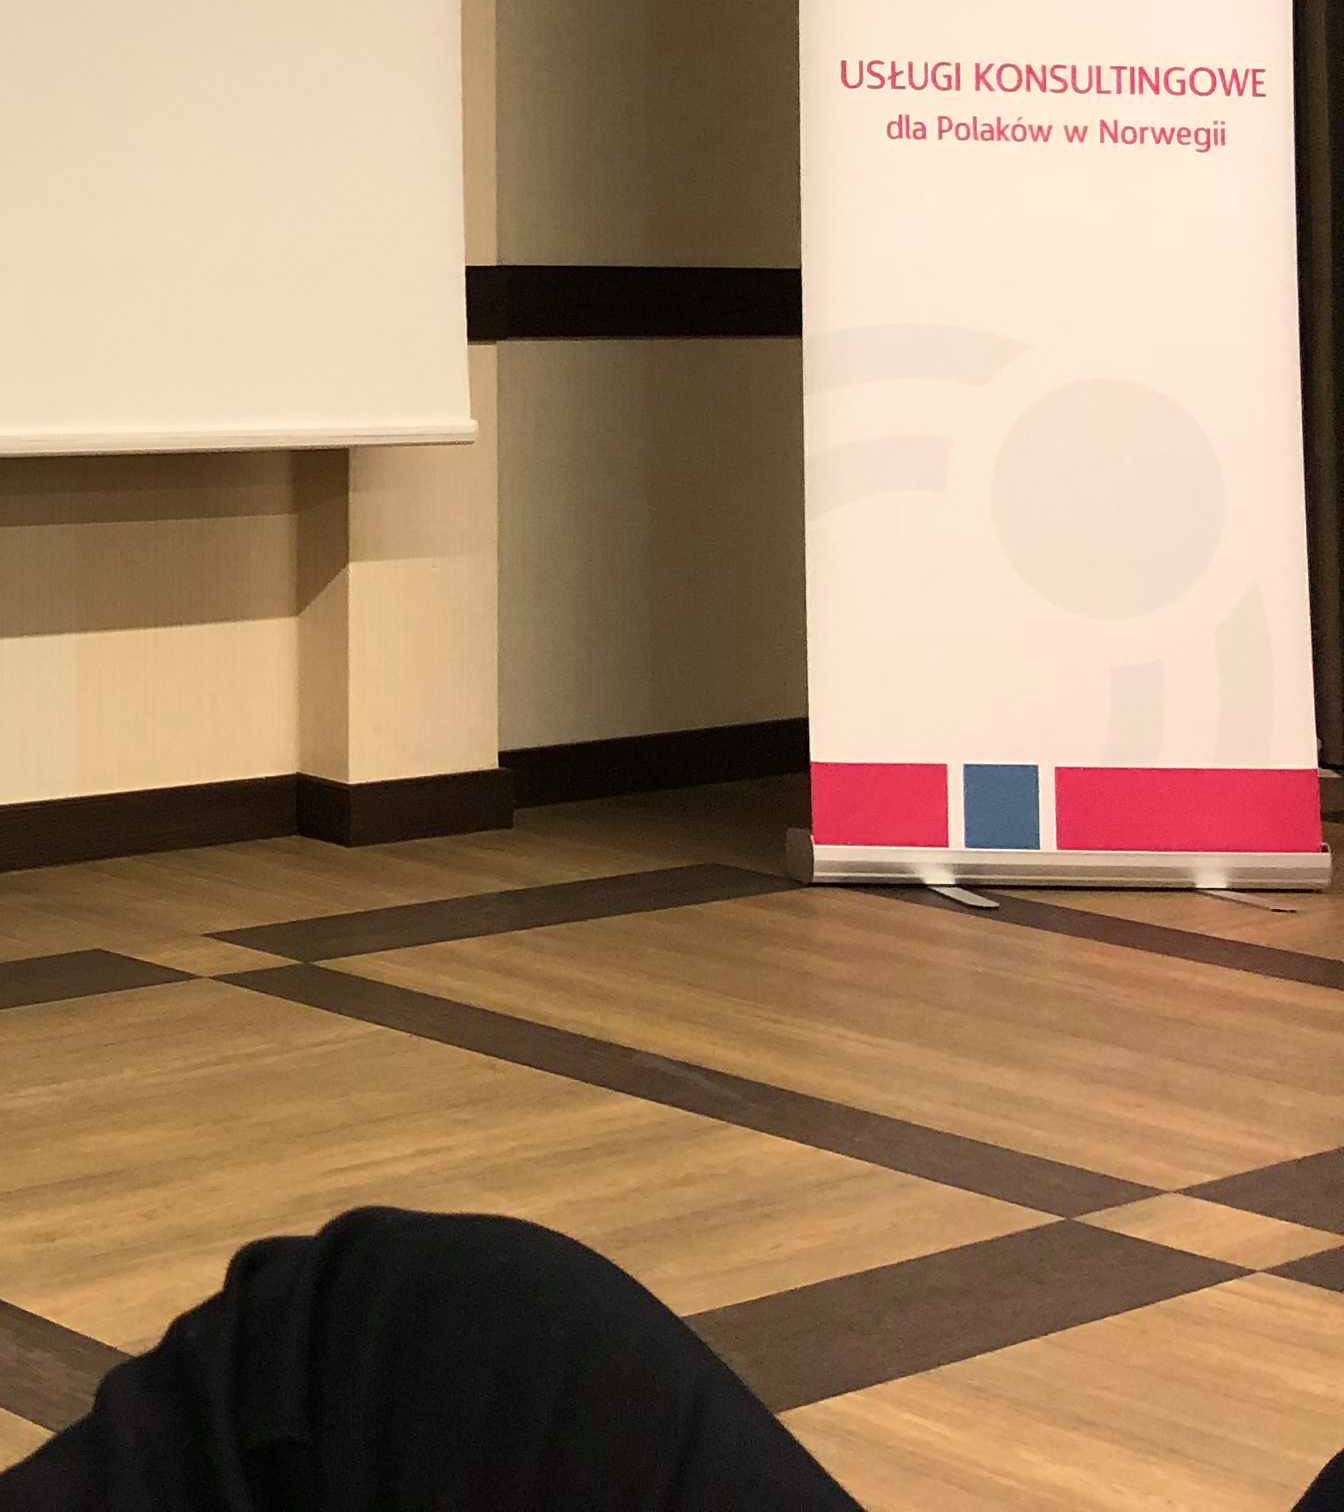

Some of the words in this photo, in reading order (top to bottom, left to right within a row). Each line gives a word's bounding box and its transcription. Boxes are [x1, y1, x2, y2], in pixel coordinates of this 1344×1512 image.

[839, 59, 962, 92] USŁUGI
[974, 62, 1267, 98] KONSULTINGOWE
[886, 114, 927, 141] dla
[937, 115, 1053, 143] Polaków
[1063, 122, 1089, 143] w
[1099, 119, 1226, 153] Norwegii
